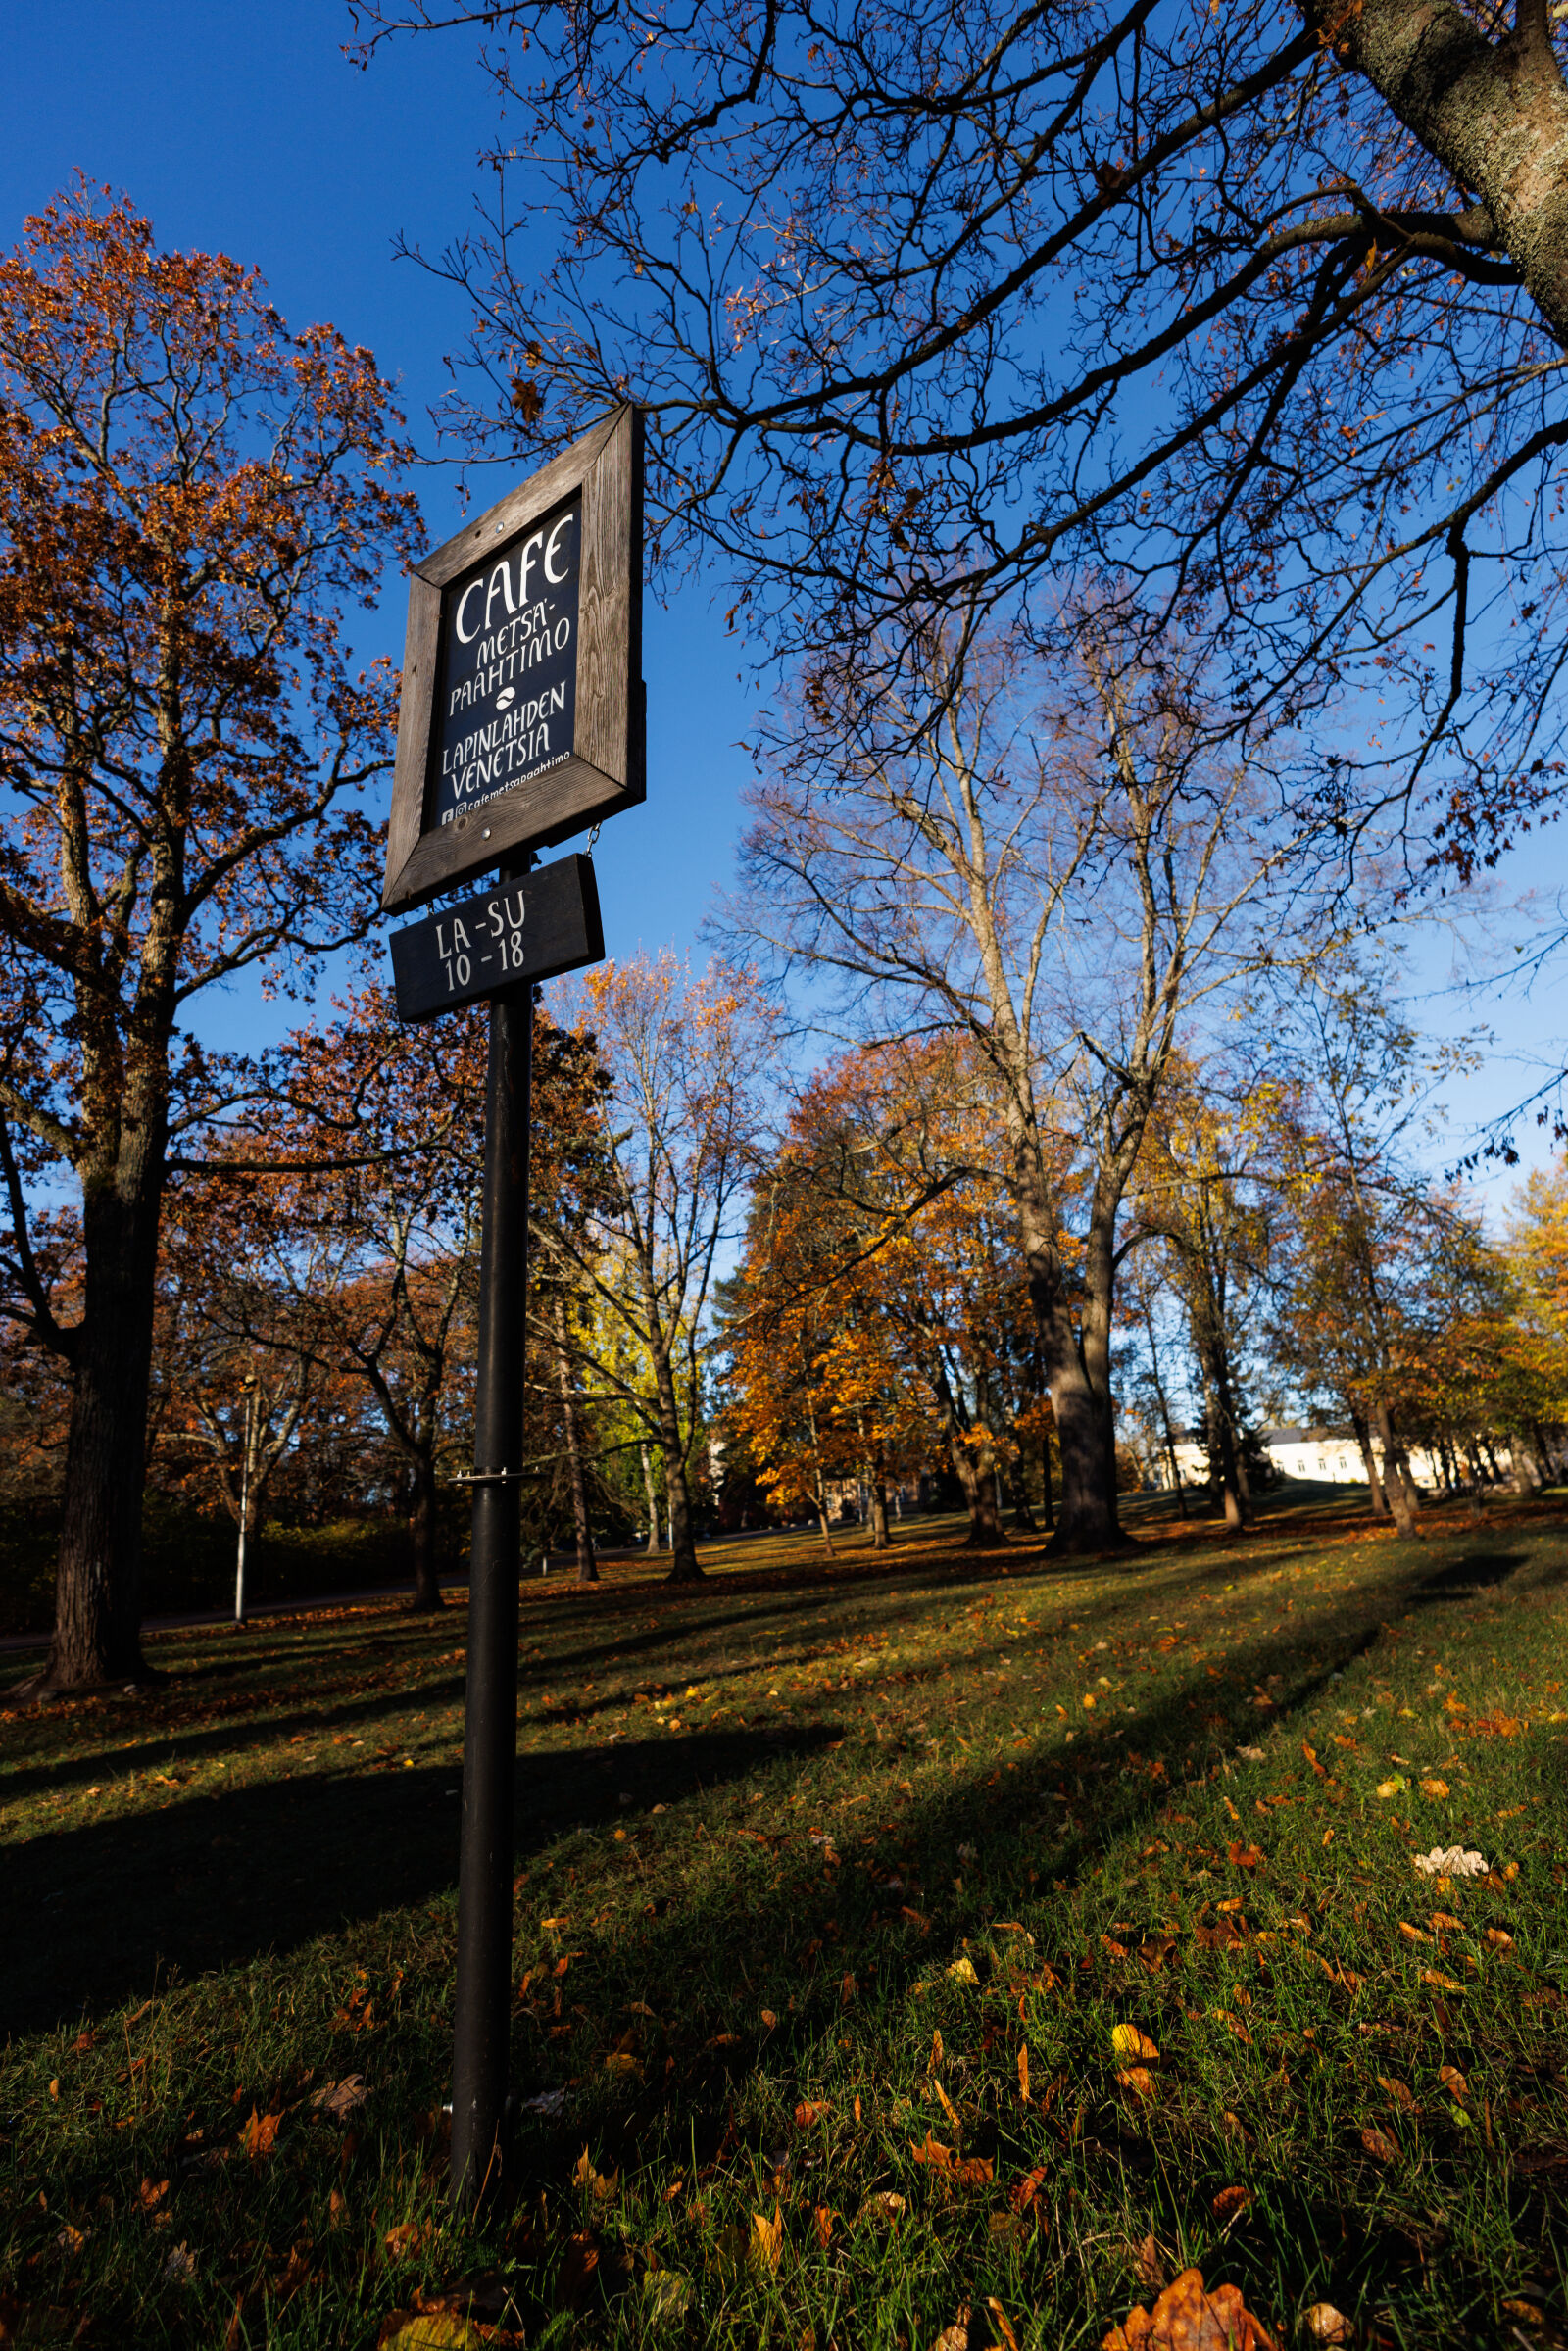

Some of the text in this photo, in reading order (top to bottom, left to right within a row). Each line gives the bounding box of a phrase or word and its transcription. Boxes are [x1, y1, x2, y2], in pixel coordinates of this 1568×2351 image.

[456, 513, 574, 644] CAFE
[449, 617, 570, 717] PAAHTIMO
[442, 679, 566, 775] LAPINLAHDEN
[451, 722, 551, 800] VENETSIA
